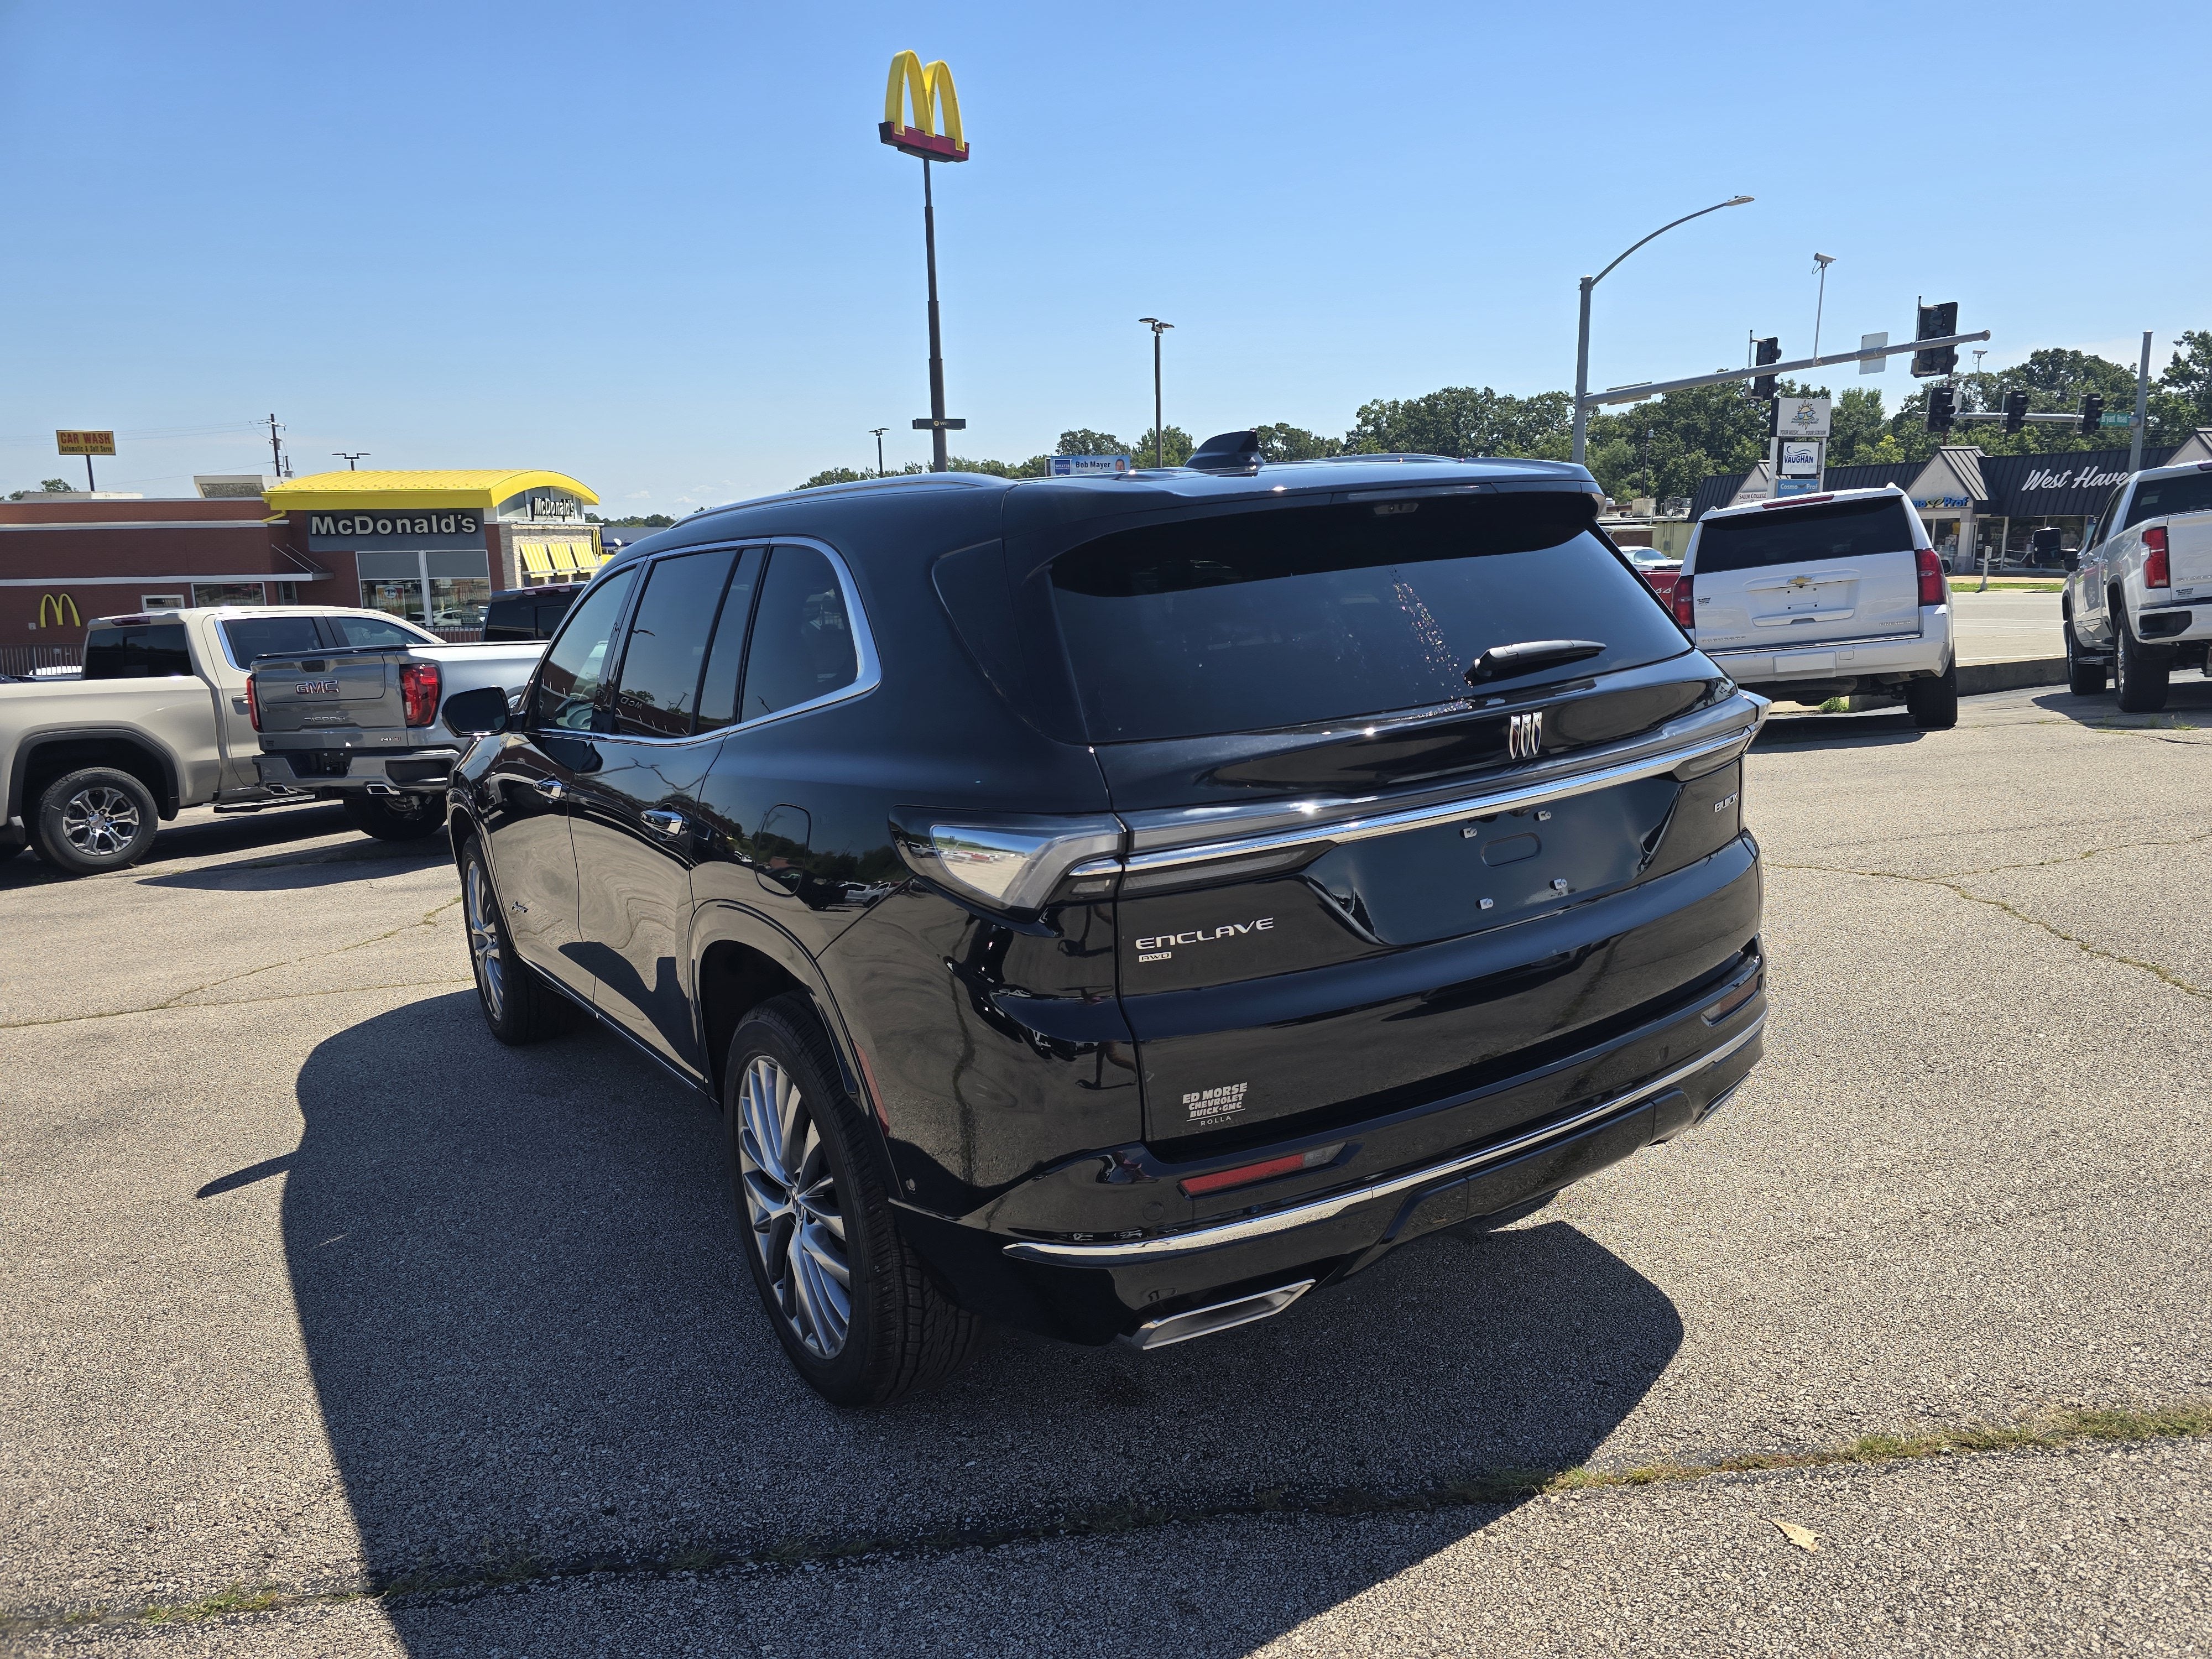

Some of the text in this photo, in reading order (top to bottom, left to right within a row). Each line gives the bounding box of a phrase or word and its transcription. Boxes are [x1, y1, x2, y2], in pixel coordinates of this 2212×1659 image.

[2101, 414, 2128, 425] Bryant Road
[60, 433, 111, 444] CAR WASH
[1090, 461, 1111, 469] Mayer
[1784, 455, 1814, 463] VAUGHAN
[2021, 466, 2129, 491] West Have
[533, 497, 576, 518] McDonald's
[1943, 497, 1969, 507] Prof
[310, 514, 477, 535] McDonald's
[294, 680, 340, 695] GMC
[1714, 791, 1739, 813] BUICK
[1135, 917, 1274, 950] ENCLAVE
[1141, 953, 1170, 961] AWD
[1182, 1082, 1248, 1104] ED MORSE
[1188, 1093, 1244, 1110] CHEVROLET
[1200, 1115, 1232, 1126] ROLLA
